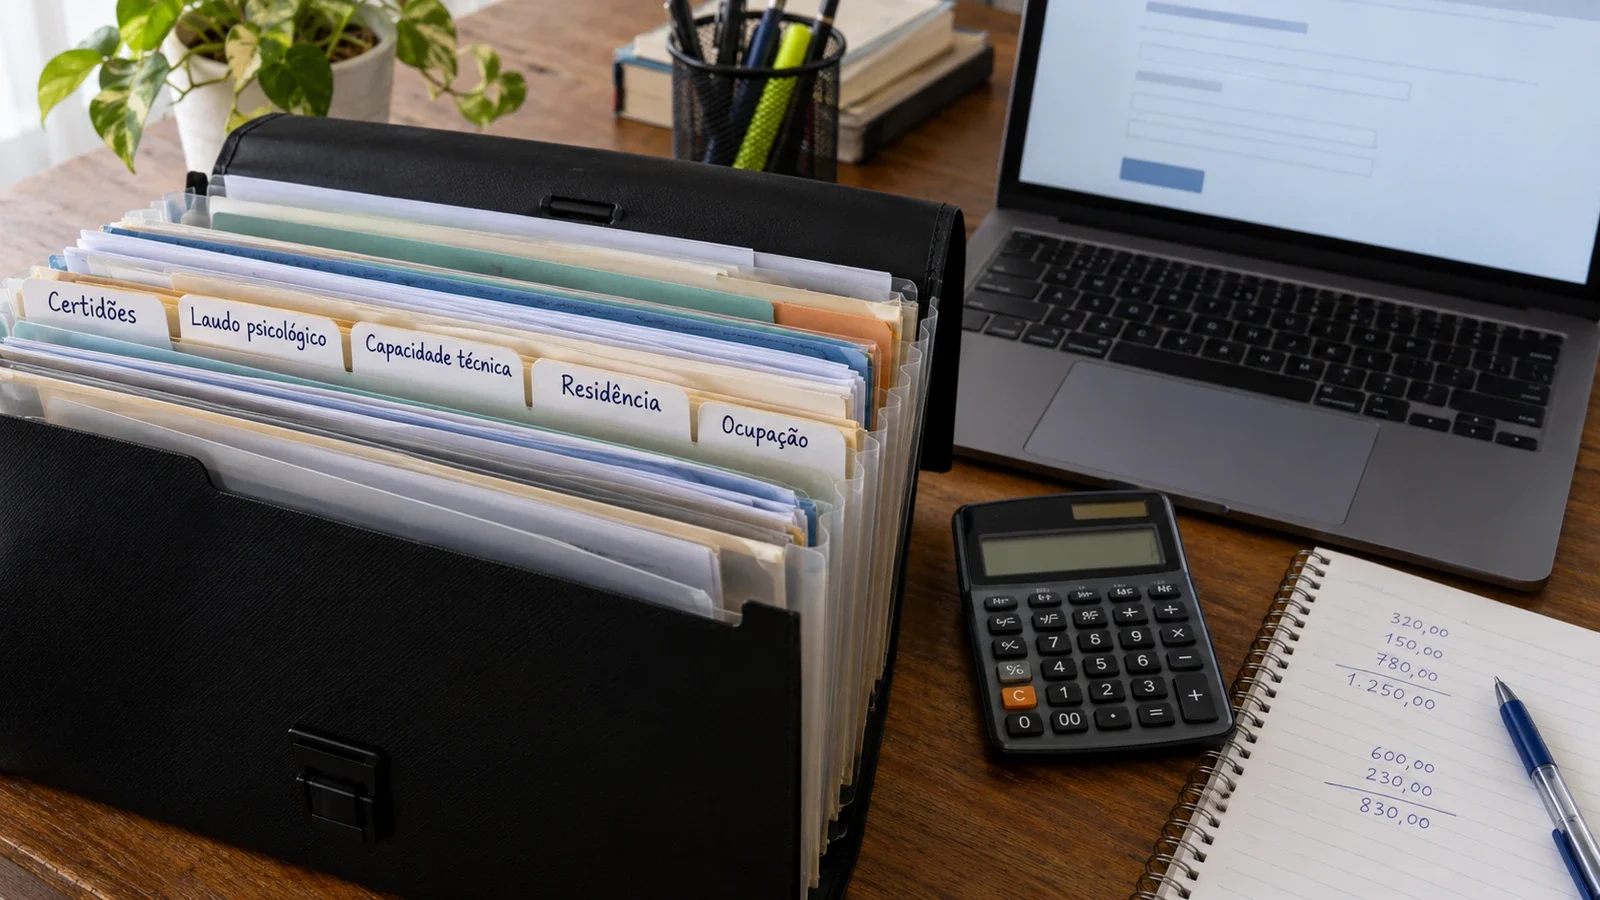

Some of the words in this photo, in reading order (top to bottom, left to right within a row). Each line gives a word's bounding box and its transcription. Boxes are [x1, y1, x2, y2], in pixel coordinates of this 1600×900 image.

[49, 292, 136, 323] Certidões
[191, 307, 240, 332] Laudo
[248, 320, 326, 350] psicológico
[366, 334, 451, 365] Capacidade
[457, 350, 512, 377] técnica
[562, 375, 661, 411] Residência
[723, 415, 808, 449] Ocupação
[1132, 631, 1141, 641] 9
[1391, 613, 1448, 637] 320,00
[1049, 637, 1057, 647] 7
[1386, 633, 1442, 659] 150,00
[1054, 661, 1064, 672] 4
[1097, 658, 1106, 669] 5
[1138, 655, 1148, 666] 6
[1377, 652, 1437, 682] 780,00
[1014, 690, 1025, 701] C
[1060, 687, 1067, 698] 1
[1102, 684, 1112, 695] 2
[1144, 681, 1154, 691] 3
[1349, 672, 1435, 710] 1.250,00
[1019, 716, 1030, 728] 0
[1059, 713, 1080, 725] 00
[1371, 746, 1434, 773] 600,00
[1366, 768, 1432, 797] 230,00
[1360, 797, 1429, 828] 830,00
